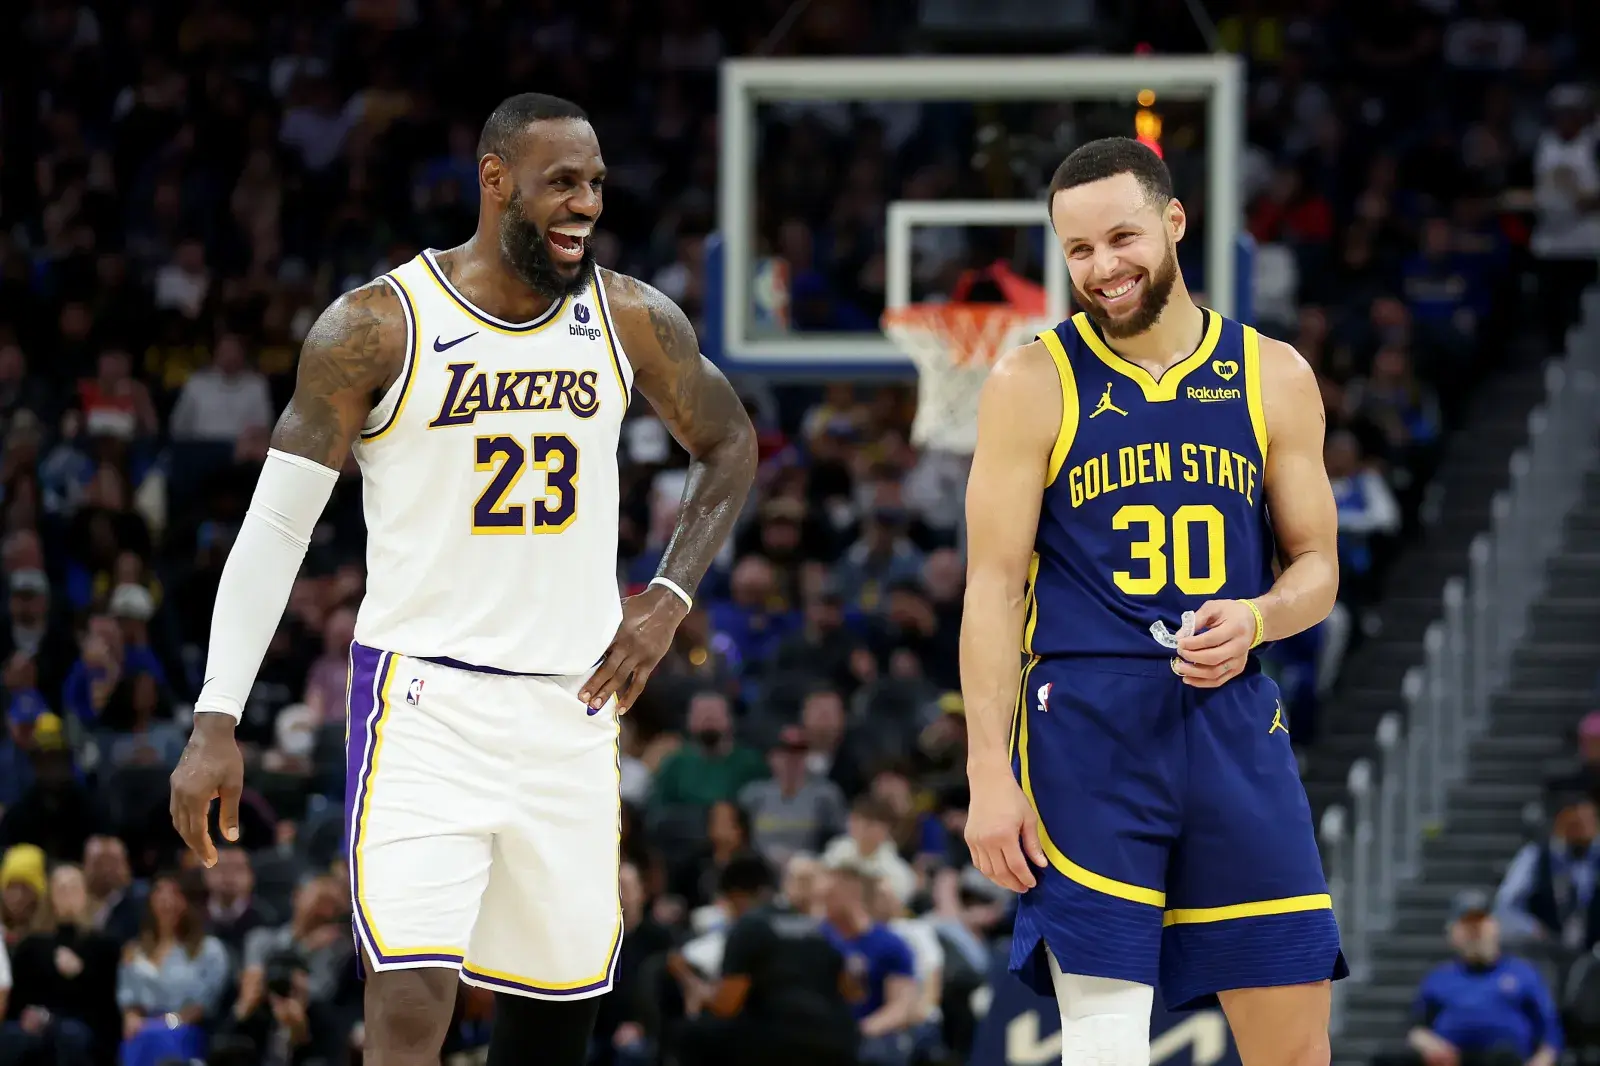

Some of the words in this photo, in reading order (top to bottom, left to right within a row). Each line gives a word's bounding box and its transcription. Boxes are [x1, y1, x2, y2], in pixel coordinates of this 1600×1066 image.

[569, 324, 601, 340] bibigo
[427, 361, 600, 430] LAKERS
[1186, 386, 1241, 399] Rakuten
[471, 433, 579, 535] 23
[1069, 442, 1172, 508] GOLDEN
[1181, 443, 1257, 507] STATE
[1112, 504, 1227, 595] 30
